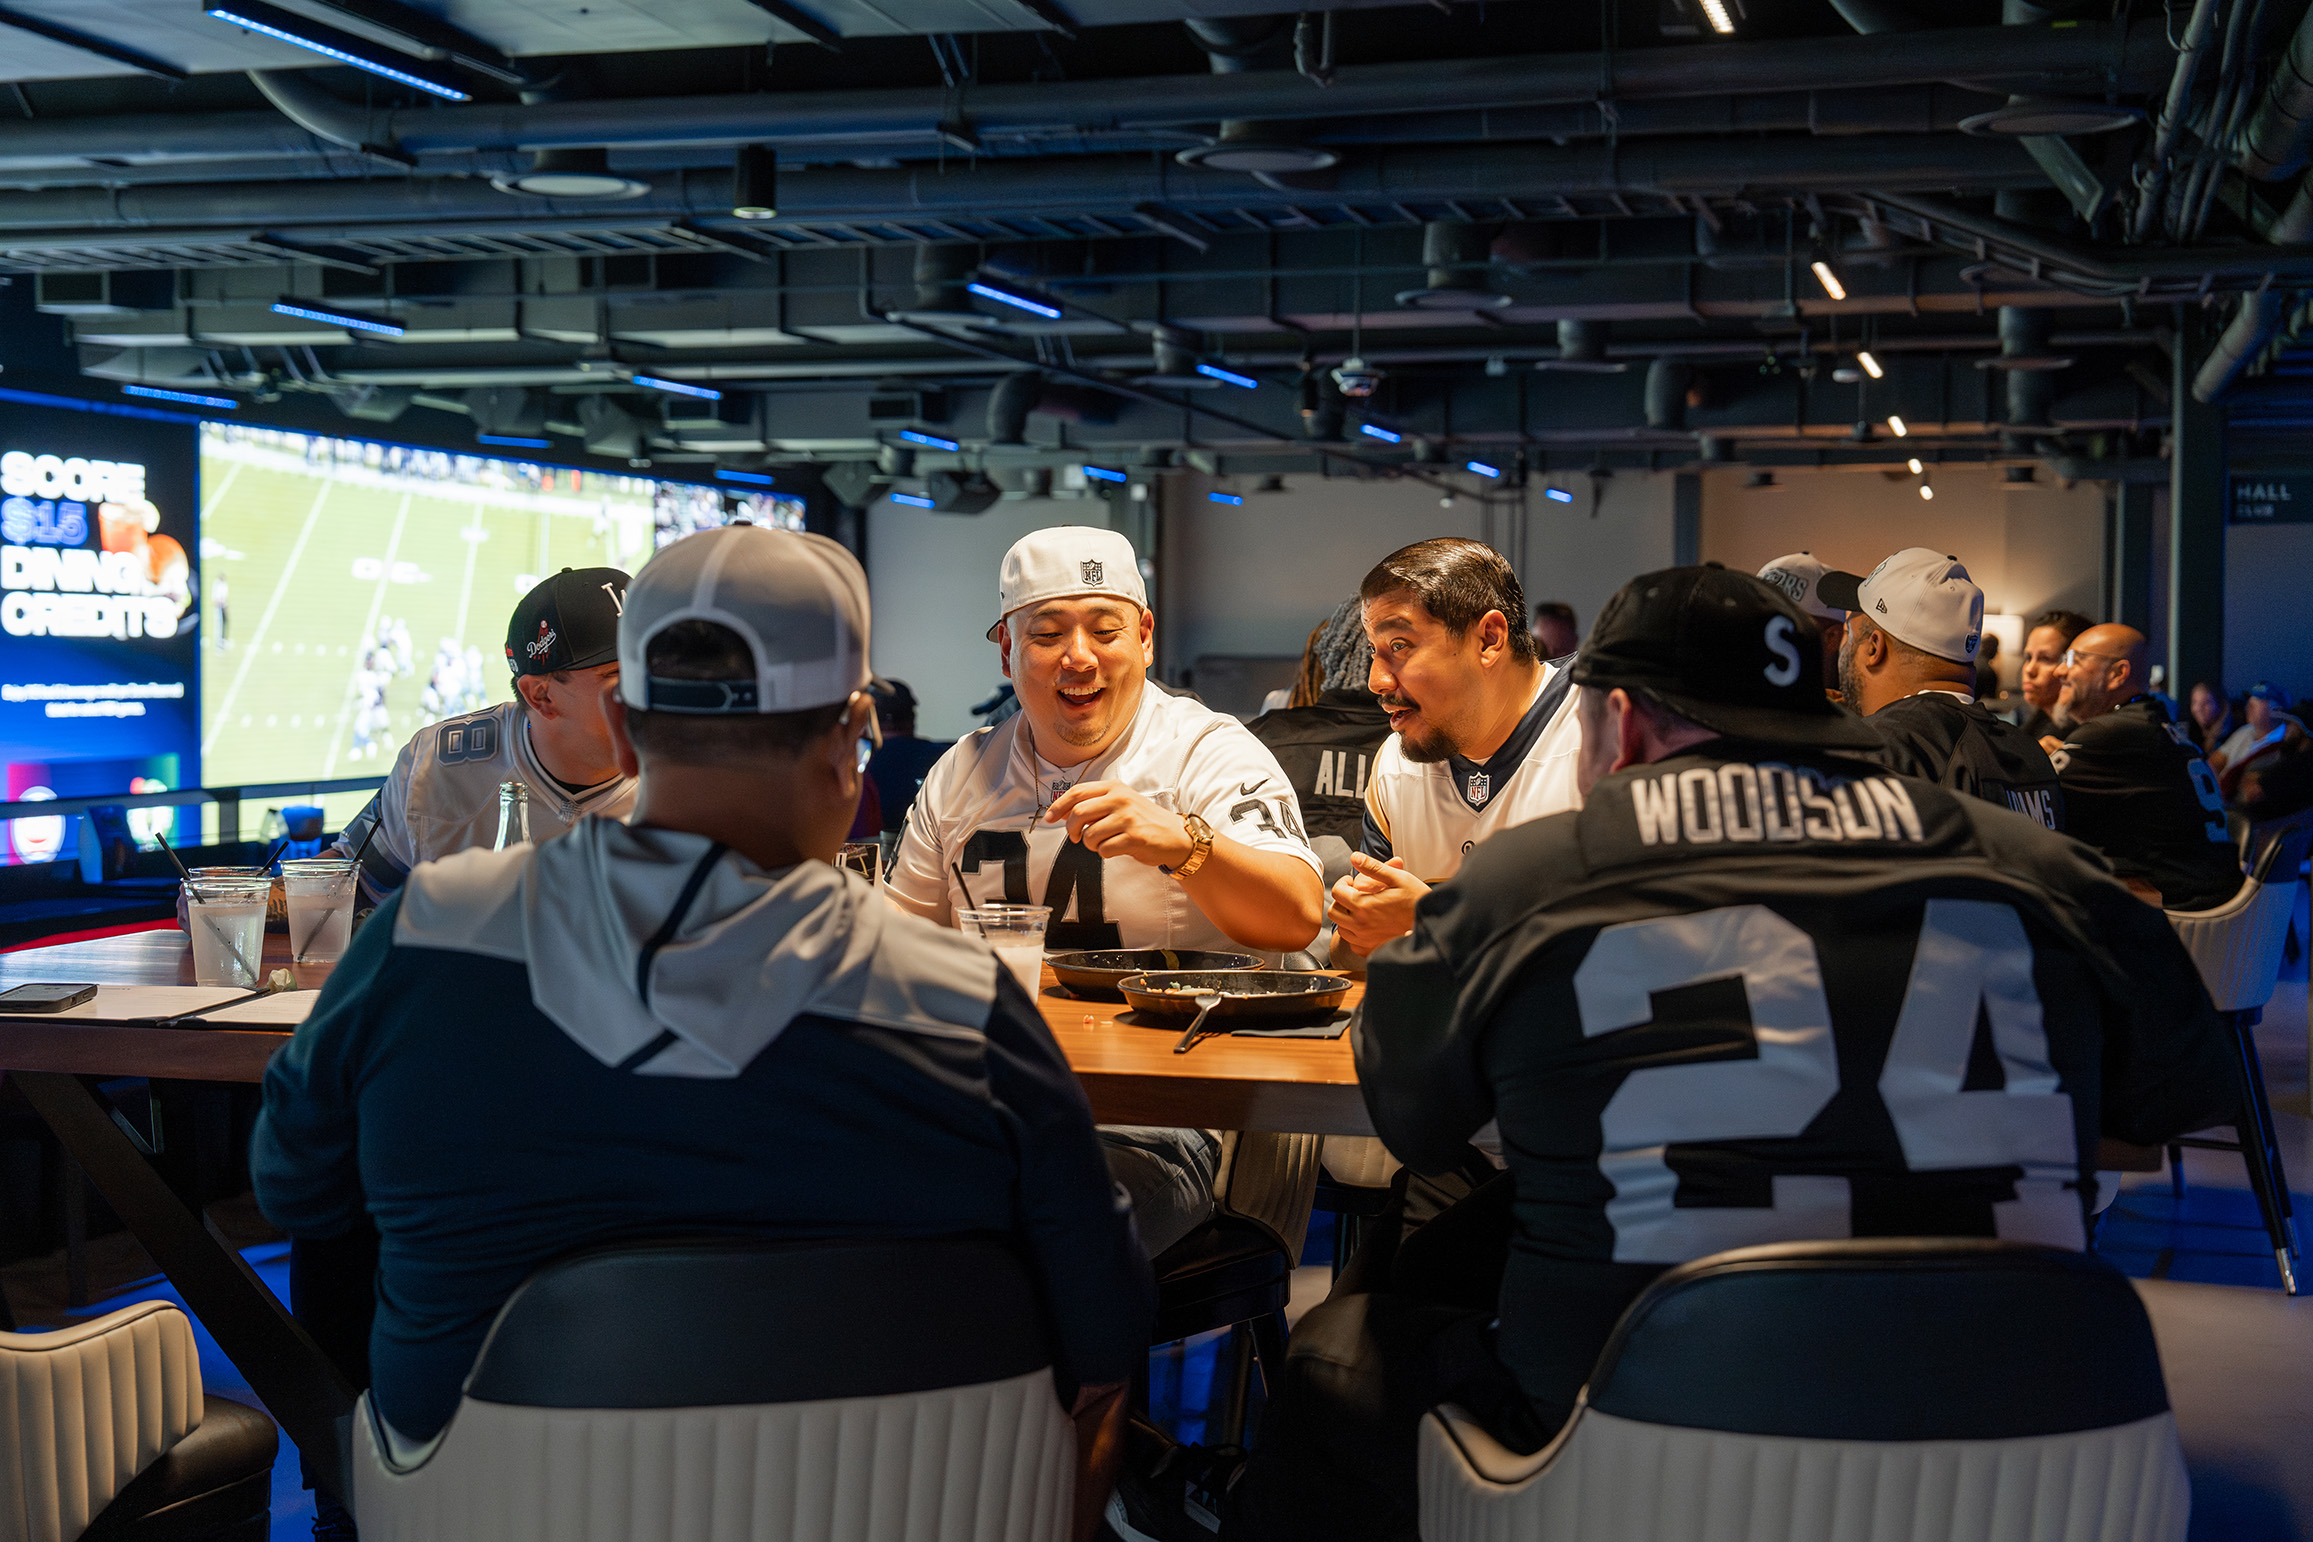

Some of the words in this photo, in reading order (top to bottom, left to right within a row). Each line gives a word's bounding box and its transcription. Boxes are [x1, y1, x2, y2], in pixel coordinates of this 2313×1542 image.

[1, 451, 146, 502] SCORE
[2237, 484, 2292, 501] HALL
[1, 496, 89, 545] $15
[1084, 570, 1101, 582] NFL
[1, 591, 178, 638] CREDITS
[527, 629, 557, 659] Dodgers
[1764, 615, 1801, 687] S
[1470, 785, 1486, 800] NFL
[961, 829, 1126, 950] 34
[1572, 898, 2088, 1264] 24
